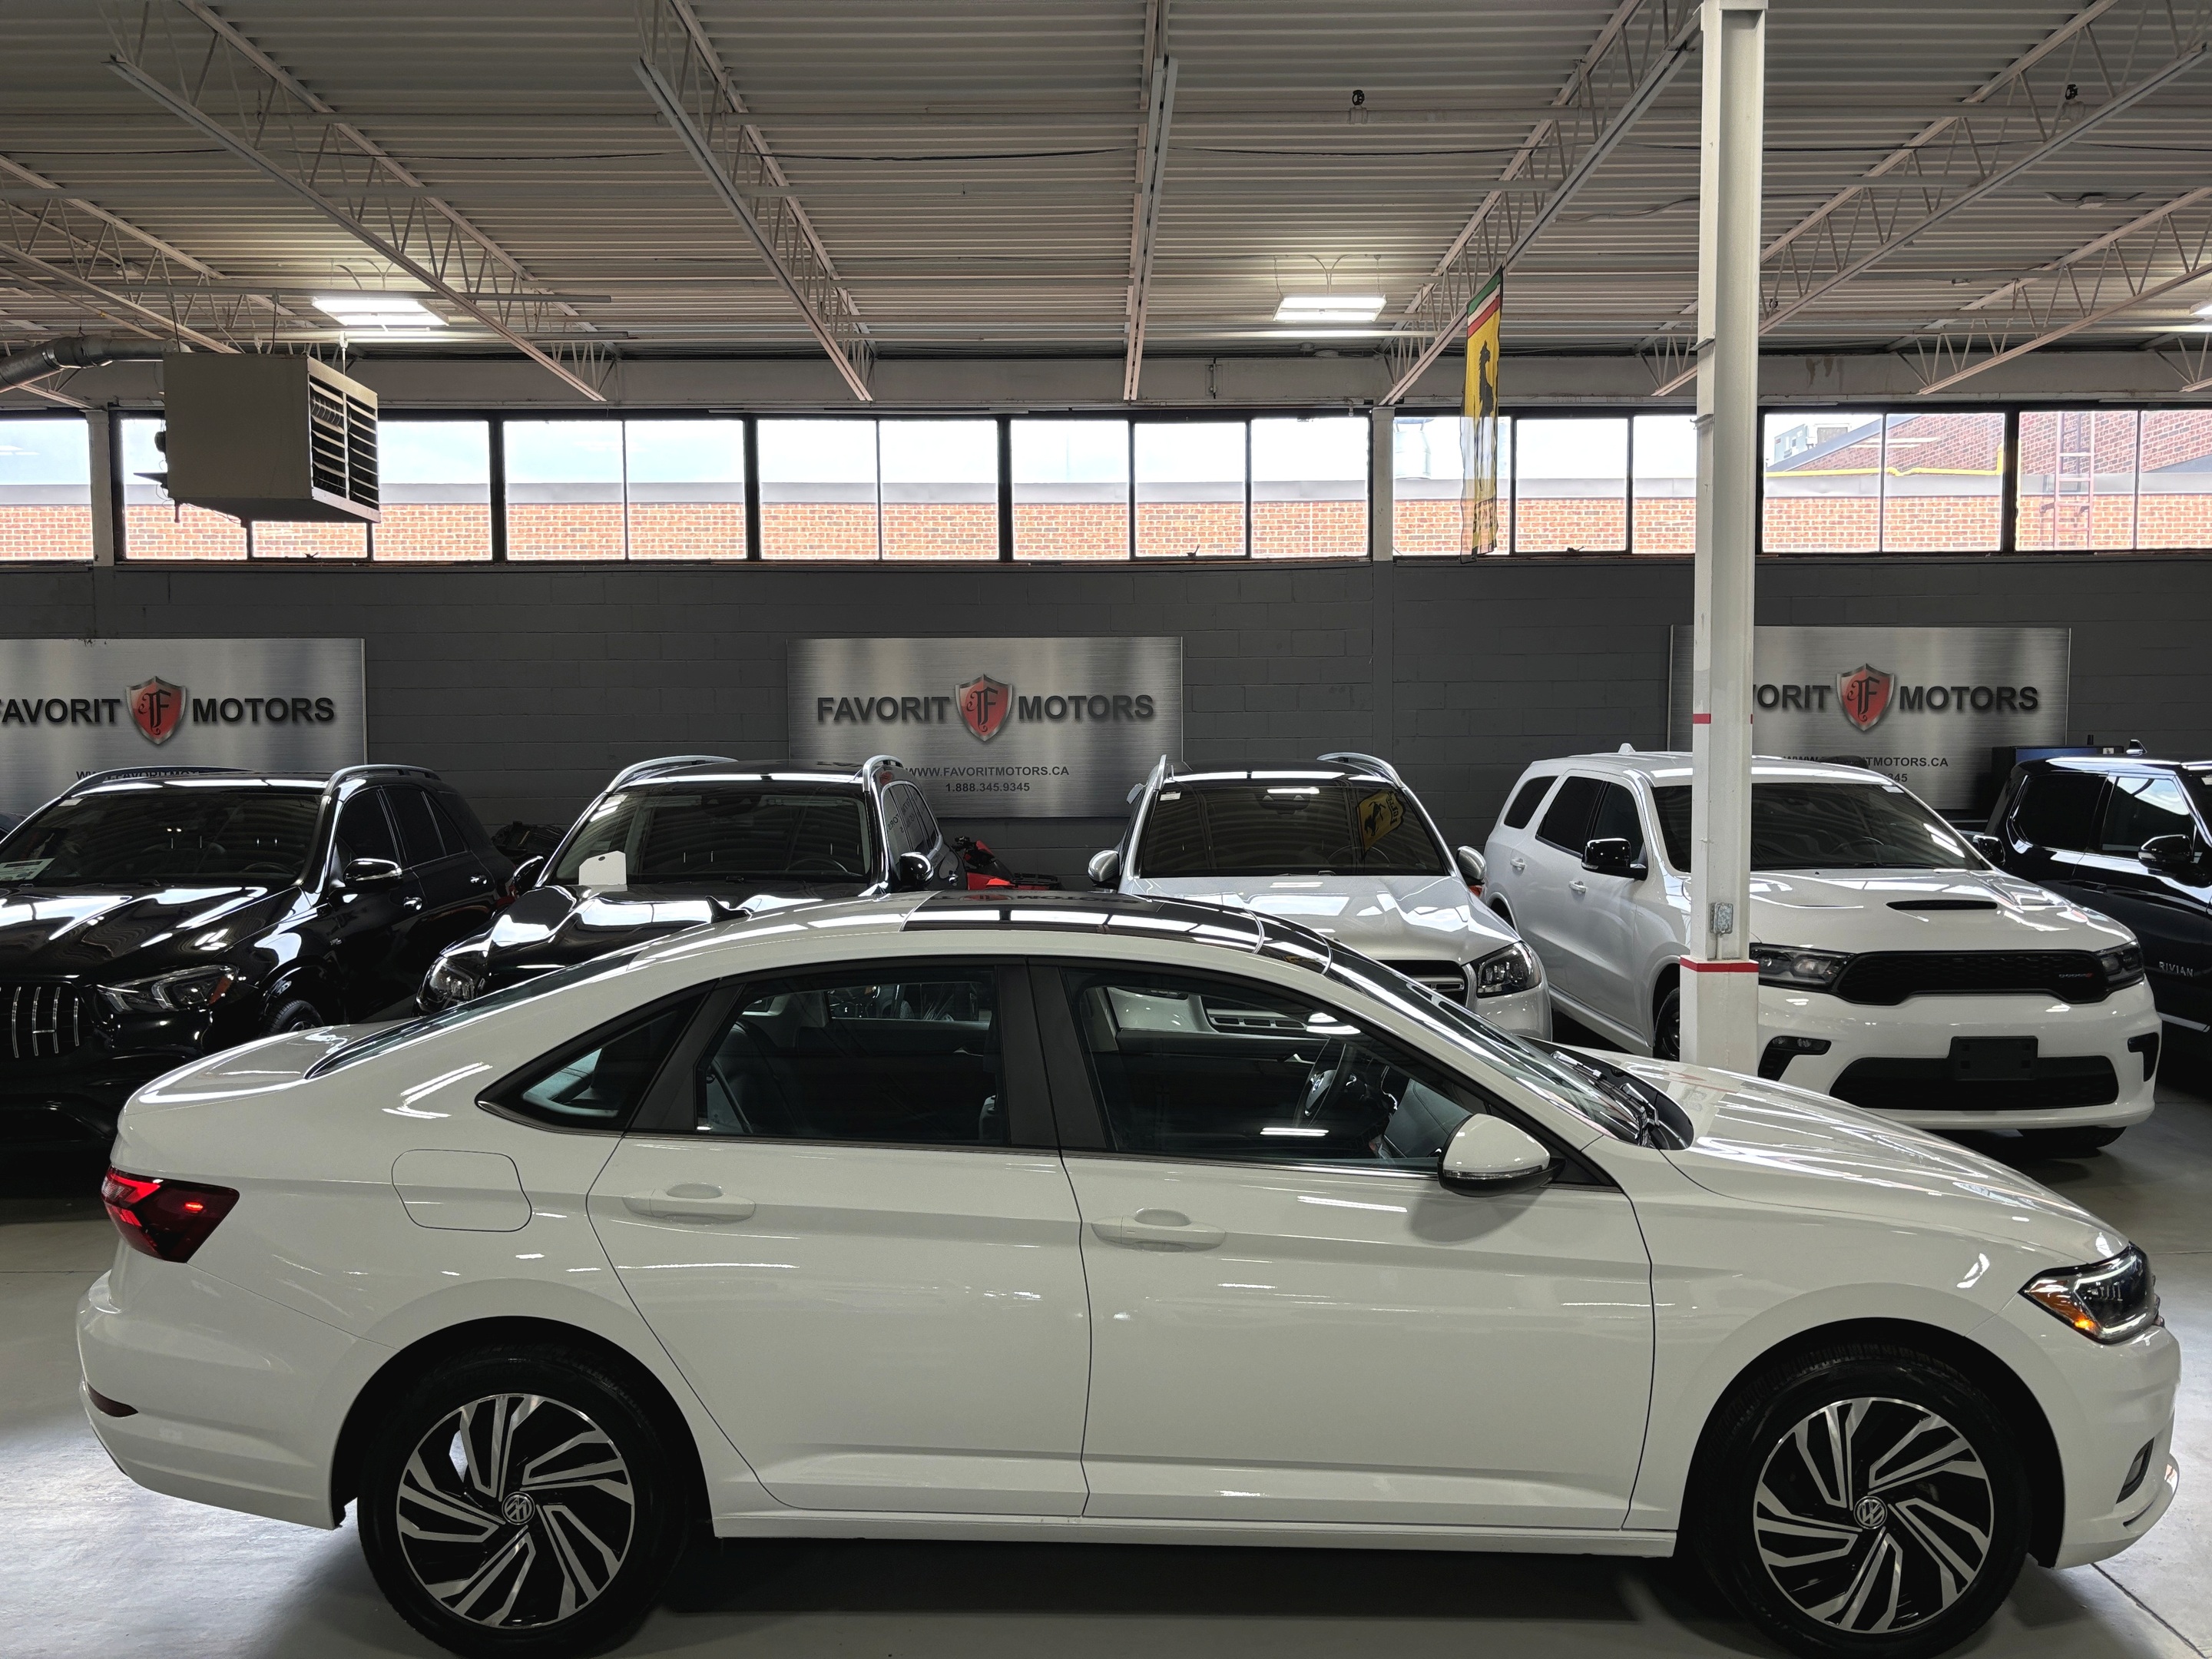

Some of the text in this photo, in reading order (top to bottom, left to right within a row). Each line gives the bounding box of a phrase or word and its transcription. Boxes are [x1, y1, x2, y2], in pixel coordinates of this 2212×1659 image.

[0, 698, 121, 723] AVORIT
[193, 697, 335, 722] MOTORS
[817, 697, 950, 720] FAVORIT
[1018, 694, 1154, 720] MOTORS
[1753, 684, 1831, 708] ORIT
[1899, 686, 2038, 710] MOTORS
[945, 783, 1030, 792] 1.888.345.9345
[2159, 961, 2194, 977] RIVIAN
